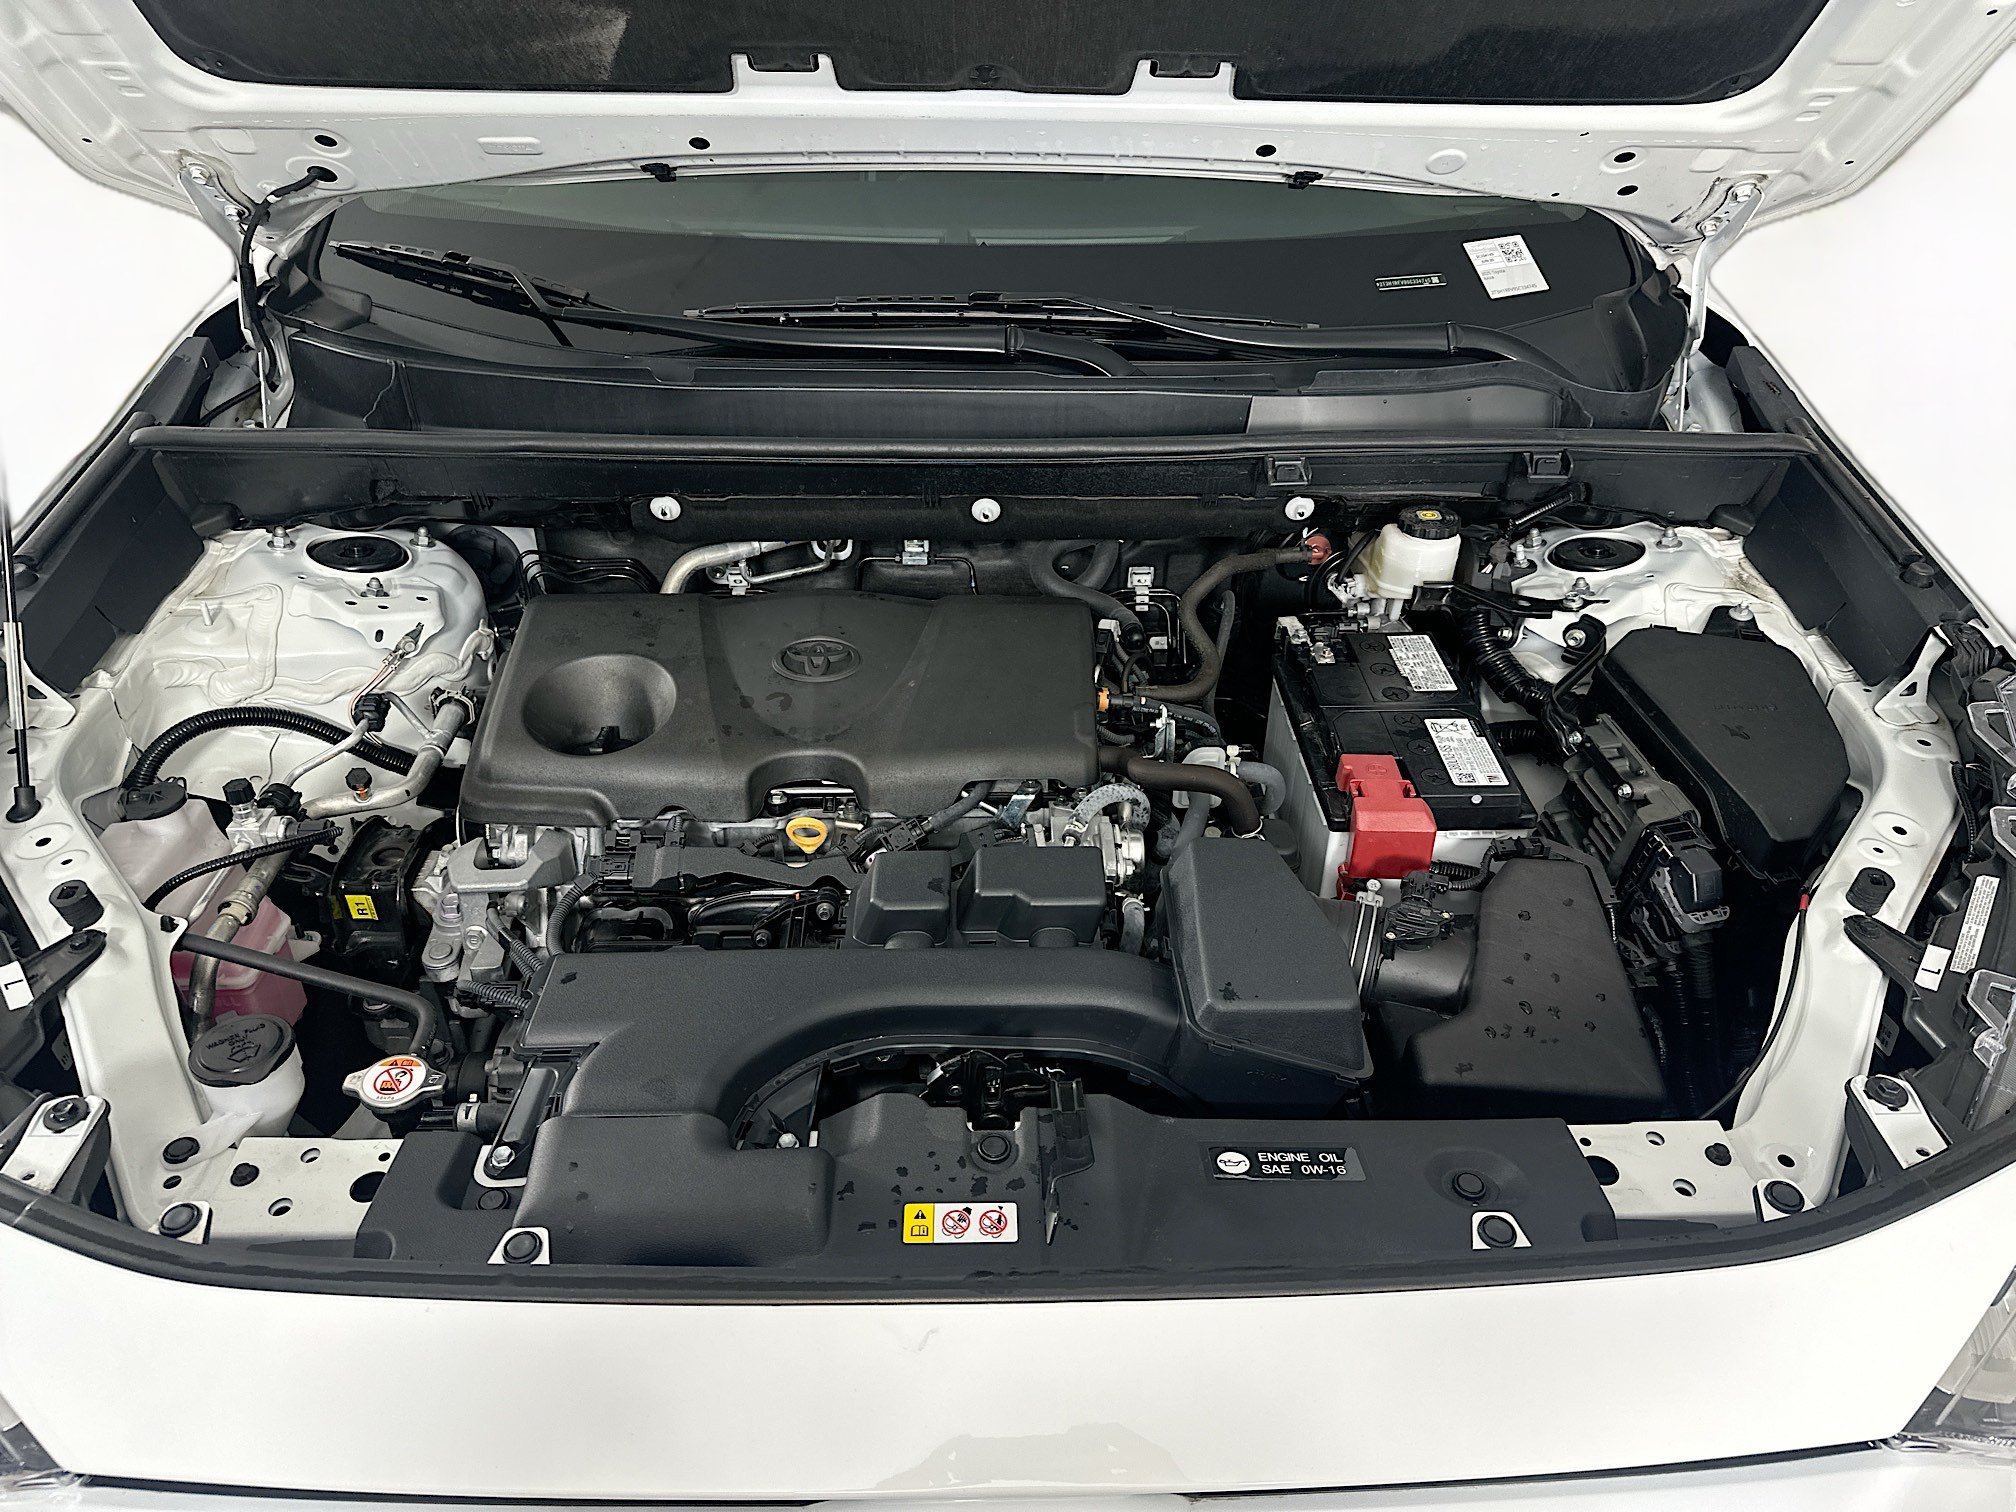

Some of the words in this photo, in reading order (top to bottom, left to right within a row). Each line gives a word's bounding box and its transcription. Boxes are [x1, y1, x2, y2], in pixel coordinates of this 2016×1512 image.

[1257, 1152, 1311, 1163] ENGINE
[1318, 1152, 1344, 1163] OIL
[1261, 1164, 1292, 1175] SAE
[1301, 1164, 1347, 1175] 0W-16
